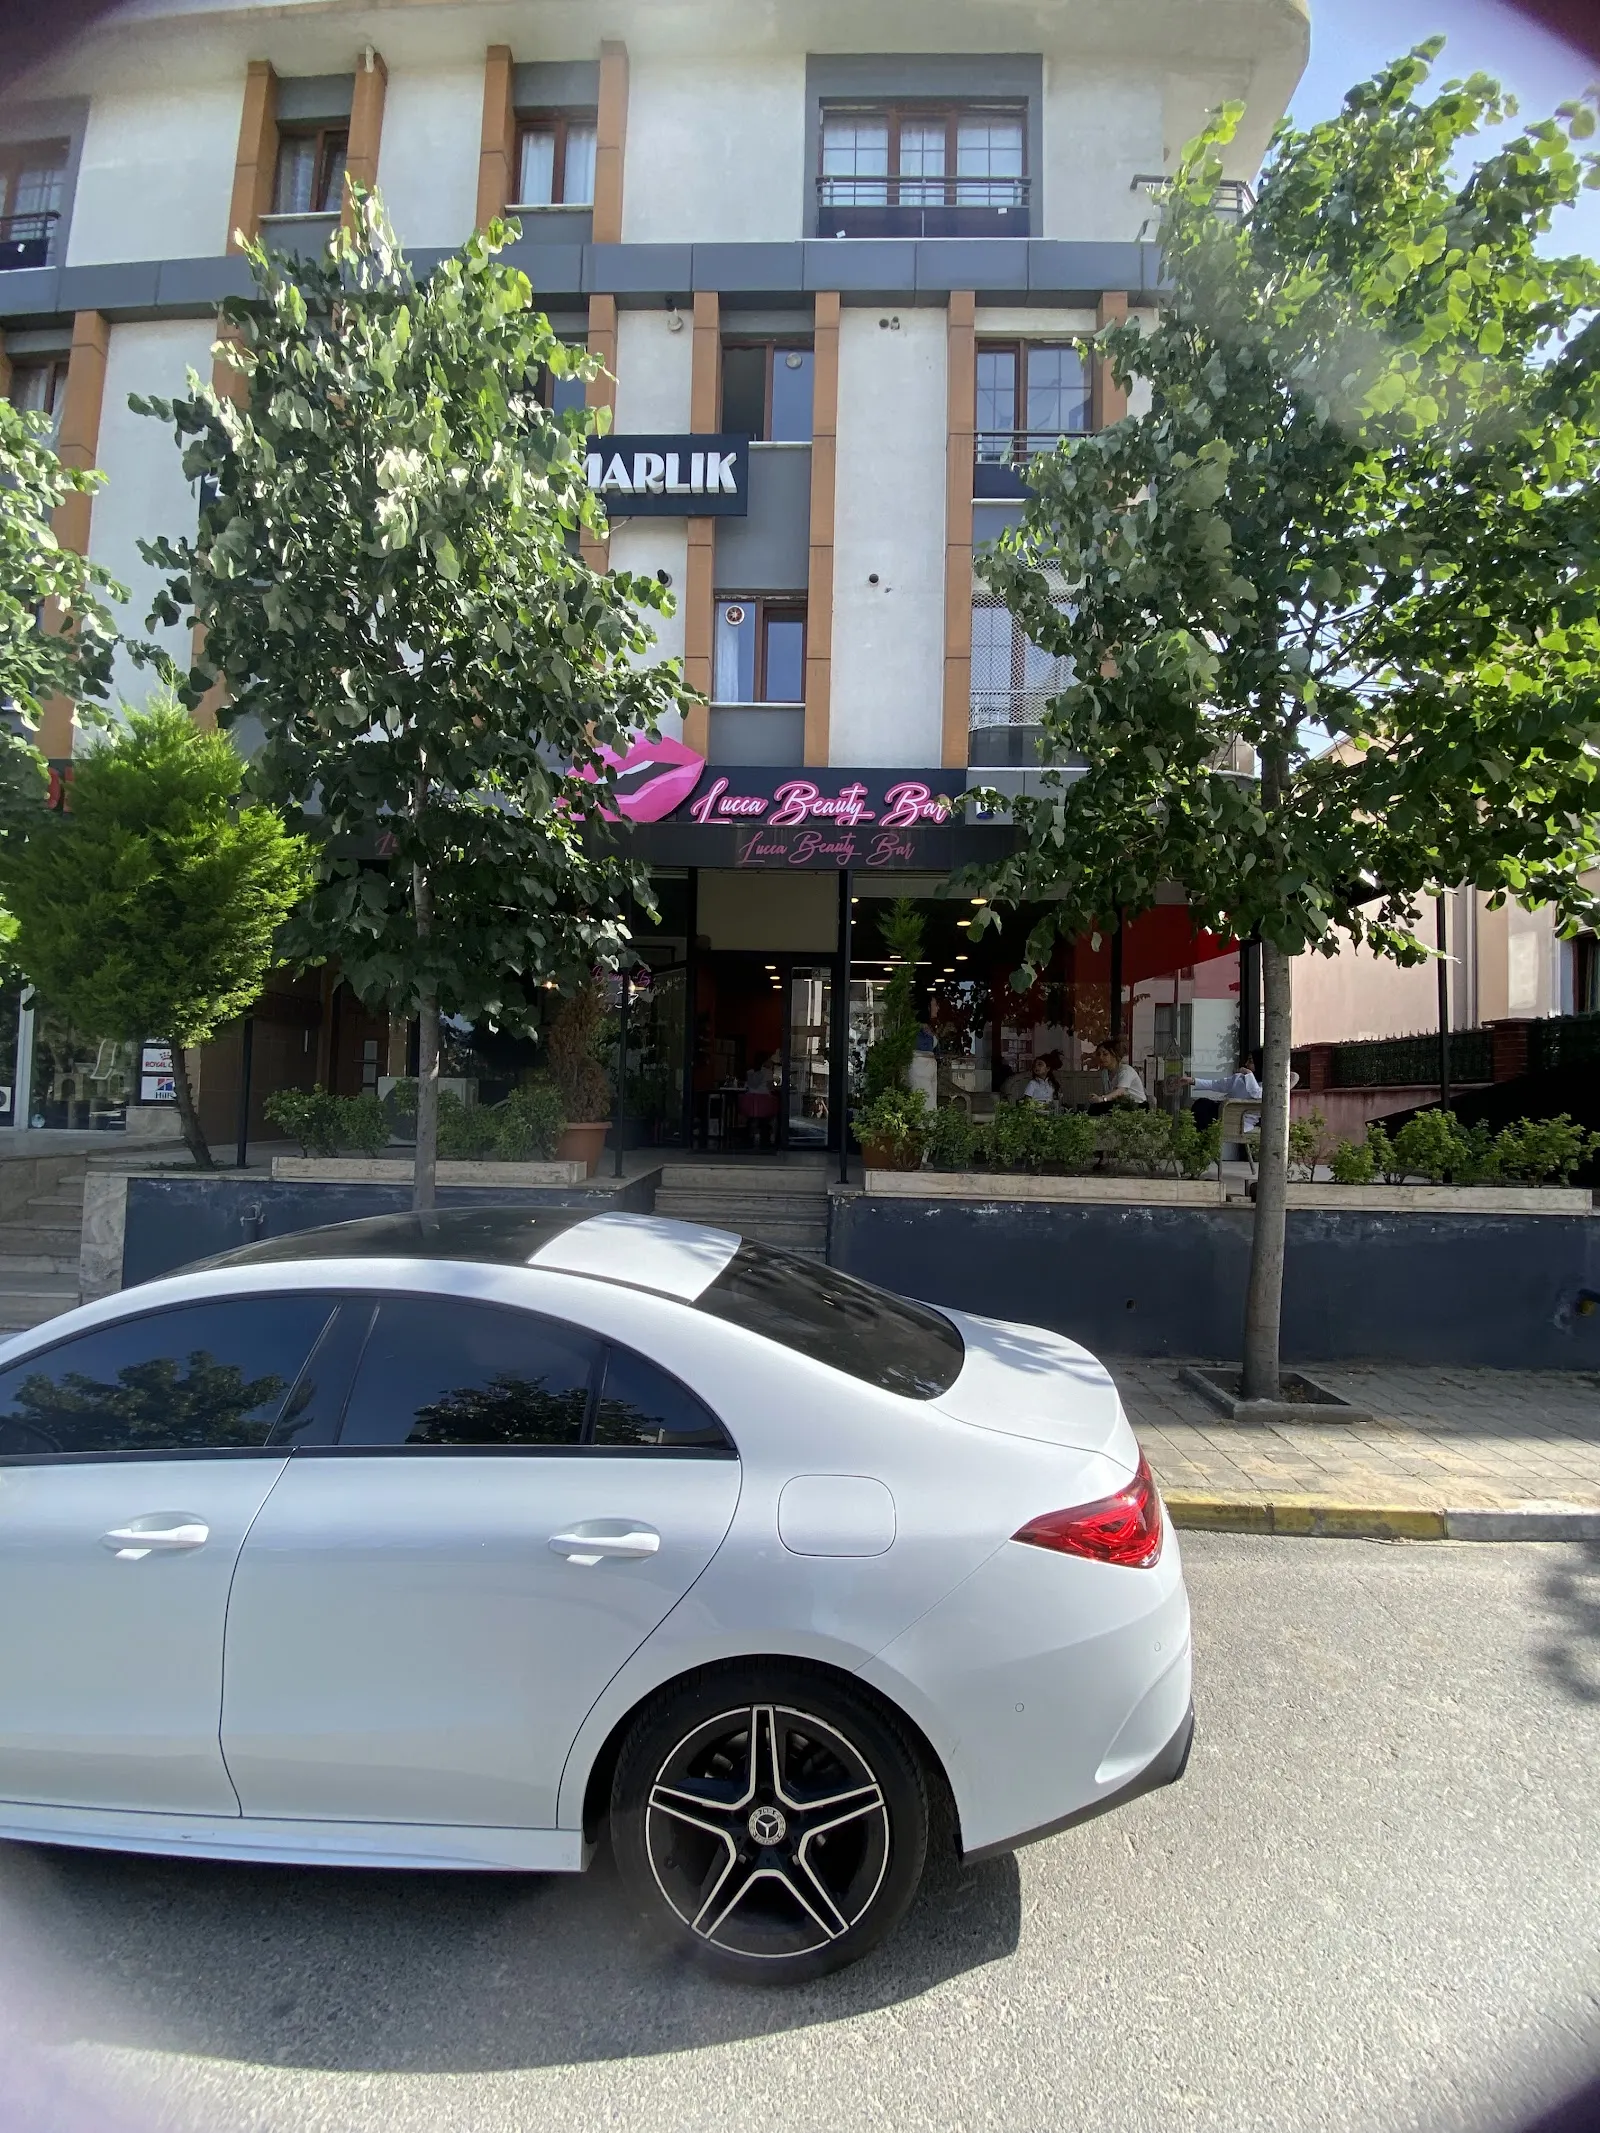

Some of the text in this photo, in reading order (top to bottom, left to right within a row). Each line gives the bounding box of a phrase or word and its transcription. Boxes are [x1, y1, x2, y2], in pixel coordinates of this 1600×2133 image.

[689, 777, 951, 827] Lucca Beauty Bar
[738, 830, 916, 866] Lucca Beauty Bar
